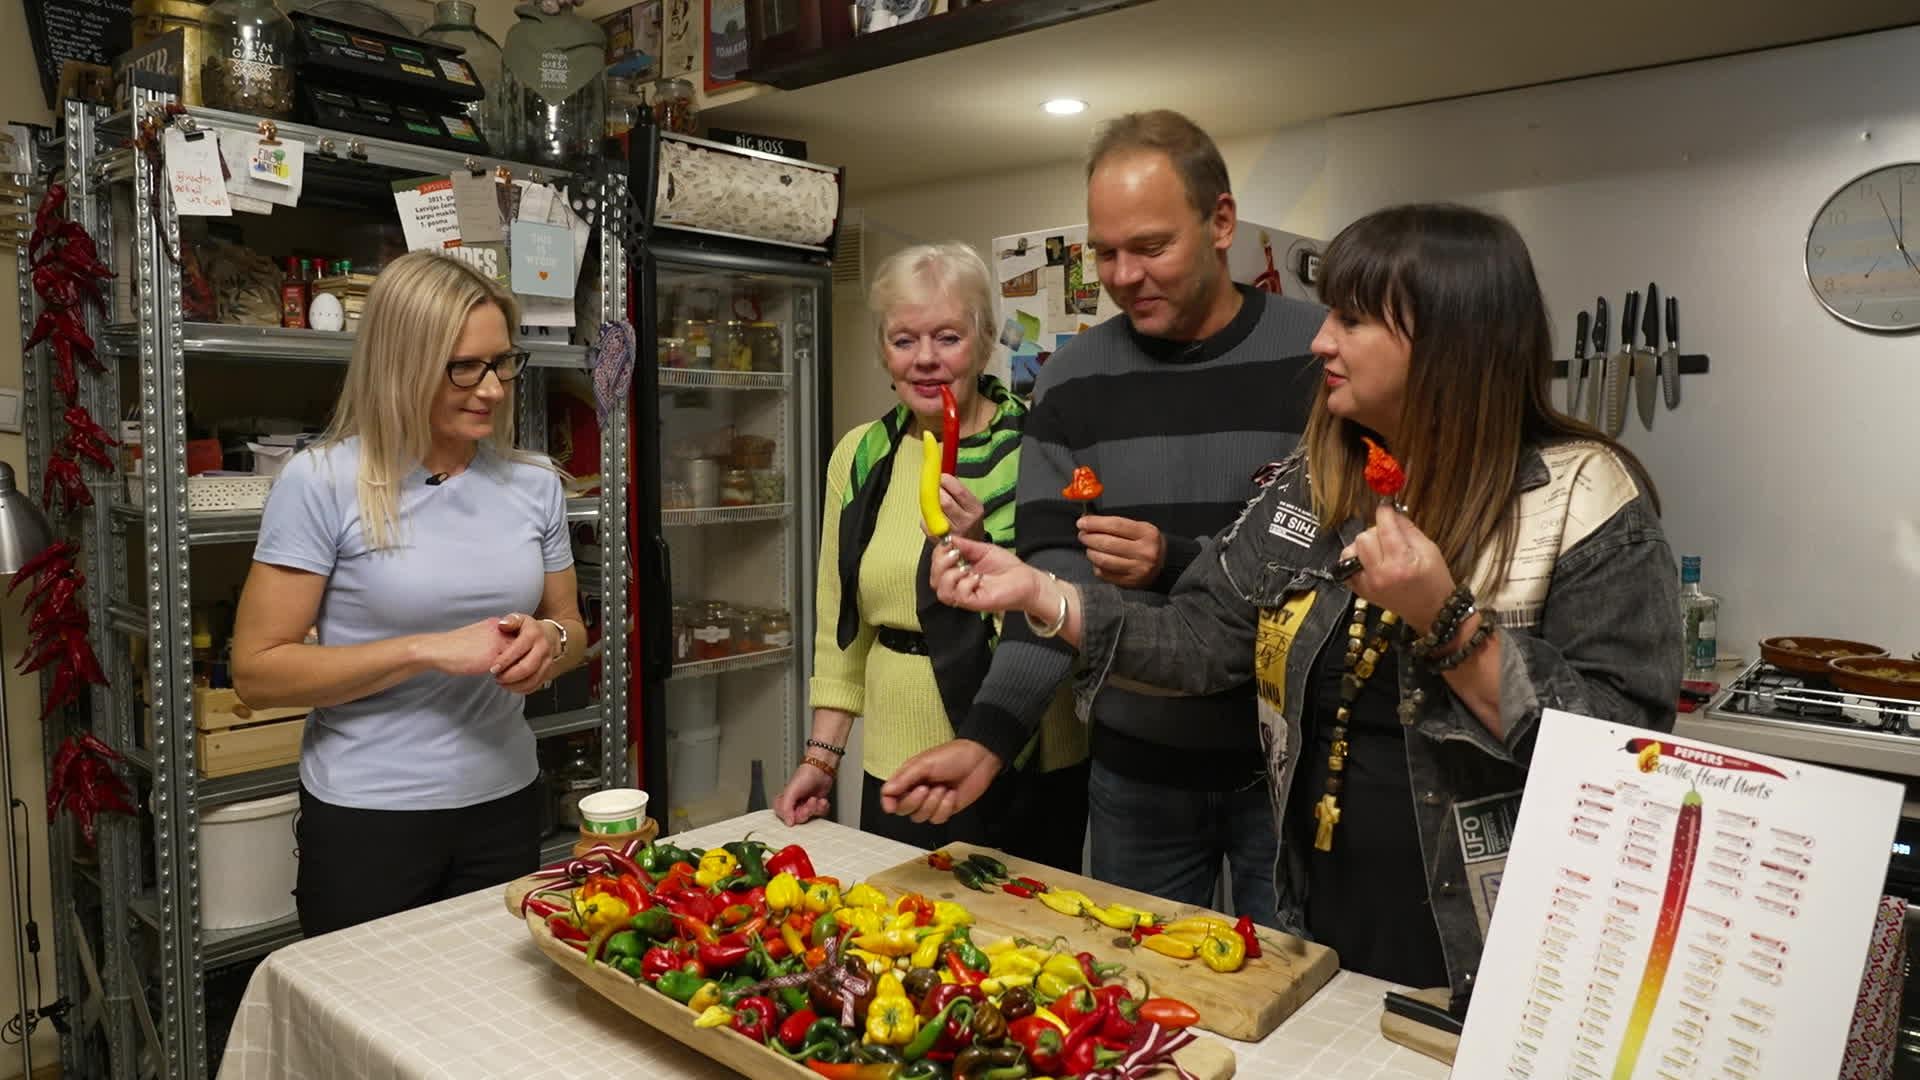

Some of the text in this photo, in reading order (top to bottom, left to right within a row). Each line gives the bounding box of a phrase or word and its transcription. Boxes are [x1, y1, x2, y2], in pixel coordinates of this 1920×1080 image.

[757, 139, 784, 155] BOSS
[1273, 511, 1287, 525] IS
[1287, 516, 1317, 538] THIS
[1674, 746, 1724, 766] PEPPERS
[1696, 767, 1731, 791] Heat
[1462, 816, 1485, 858] UFO
